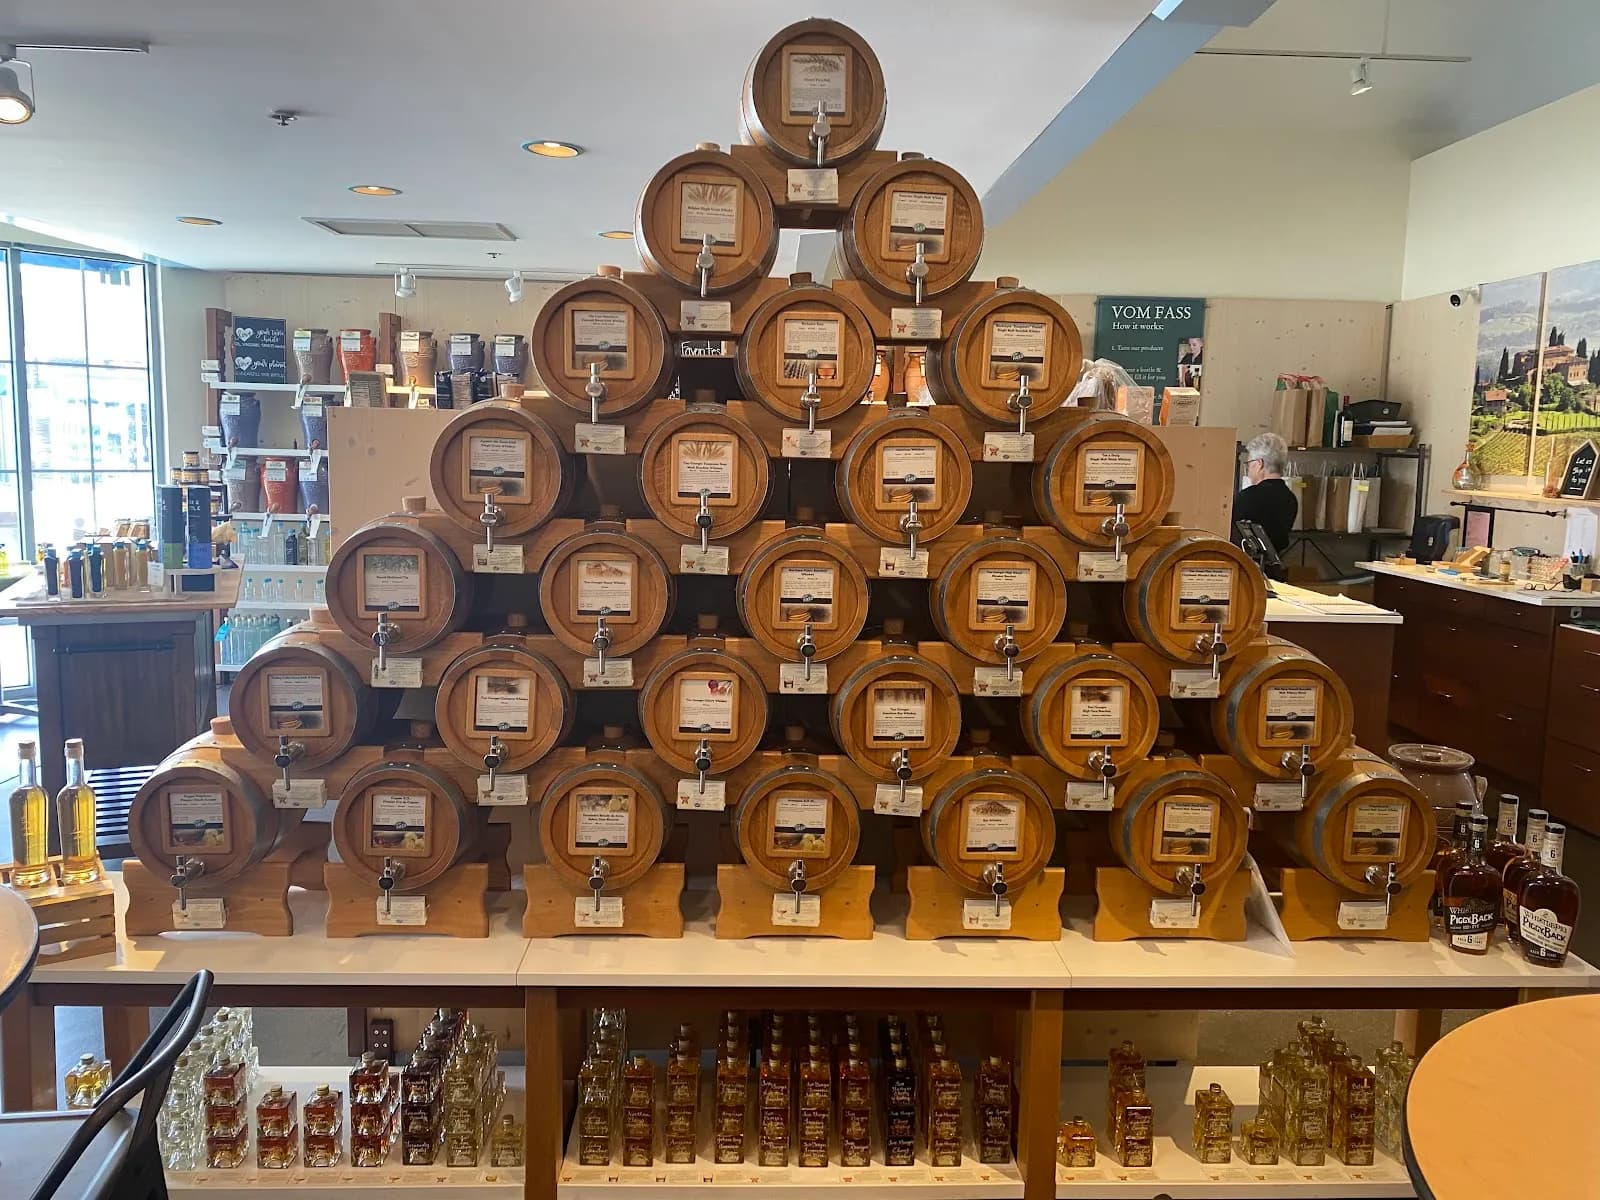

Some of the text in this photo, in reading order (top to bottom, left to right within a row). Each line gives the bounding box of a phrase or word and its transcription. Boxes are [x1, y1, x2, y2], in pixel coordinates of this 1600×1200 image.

[1111, 305, 1191, 319] VOM FASS
[1112, 321, 1164, 330] How it works:
[1532, 834, 1538, 843] 6
[1550, 849, 1556, 858] 6
[1467, 935, 1473, 944] 6
[1540, 947, 1546, 957] 6
